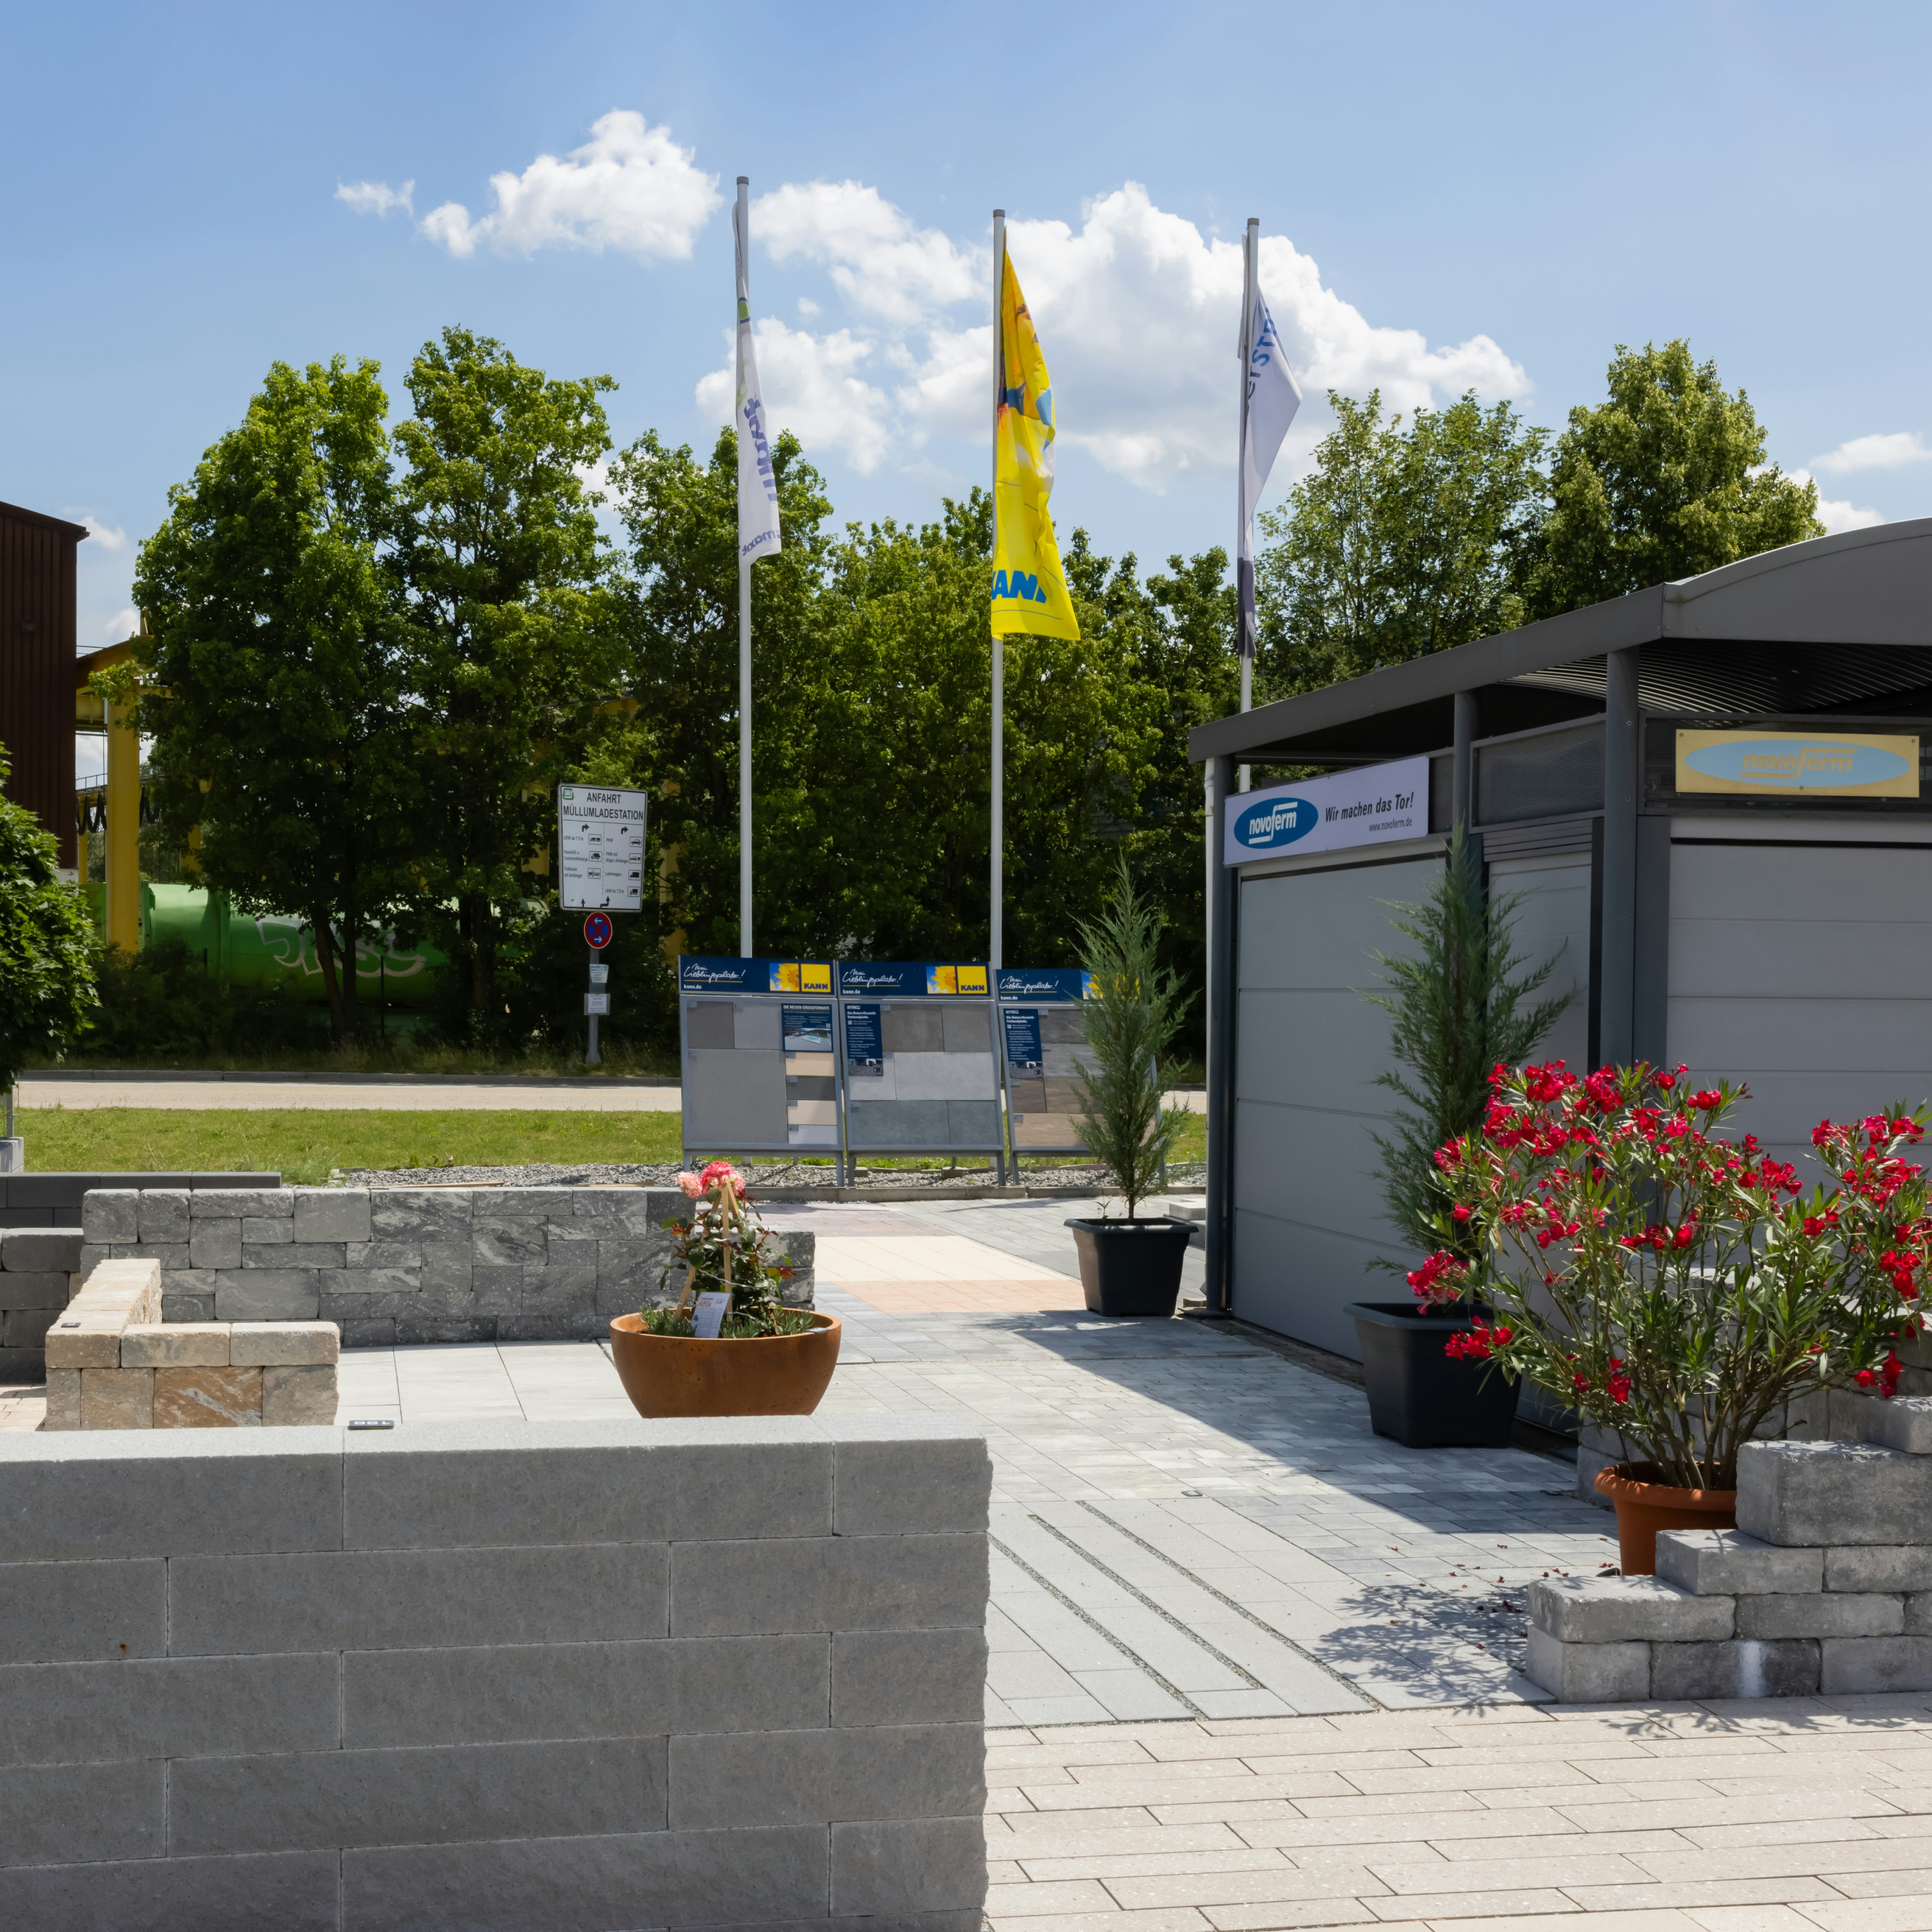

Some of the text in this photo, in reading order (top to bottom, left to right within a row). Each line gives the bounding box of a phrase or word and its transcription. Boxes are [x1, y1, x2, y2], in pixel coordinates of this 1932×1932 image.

[1740, 747, 1855, 779] novoferm
[587, 792, 621, 804] ANFAHRT
[1325, 791, 1414, 822] Wir machen das Tor!
[563, 804, 644, 821] MÜLLUMLADESTATION
[1249, 801, 1298, 845] novoferm
[1368, 816, 1412, 832] www.novoferm.de
